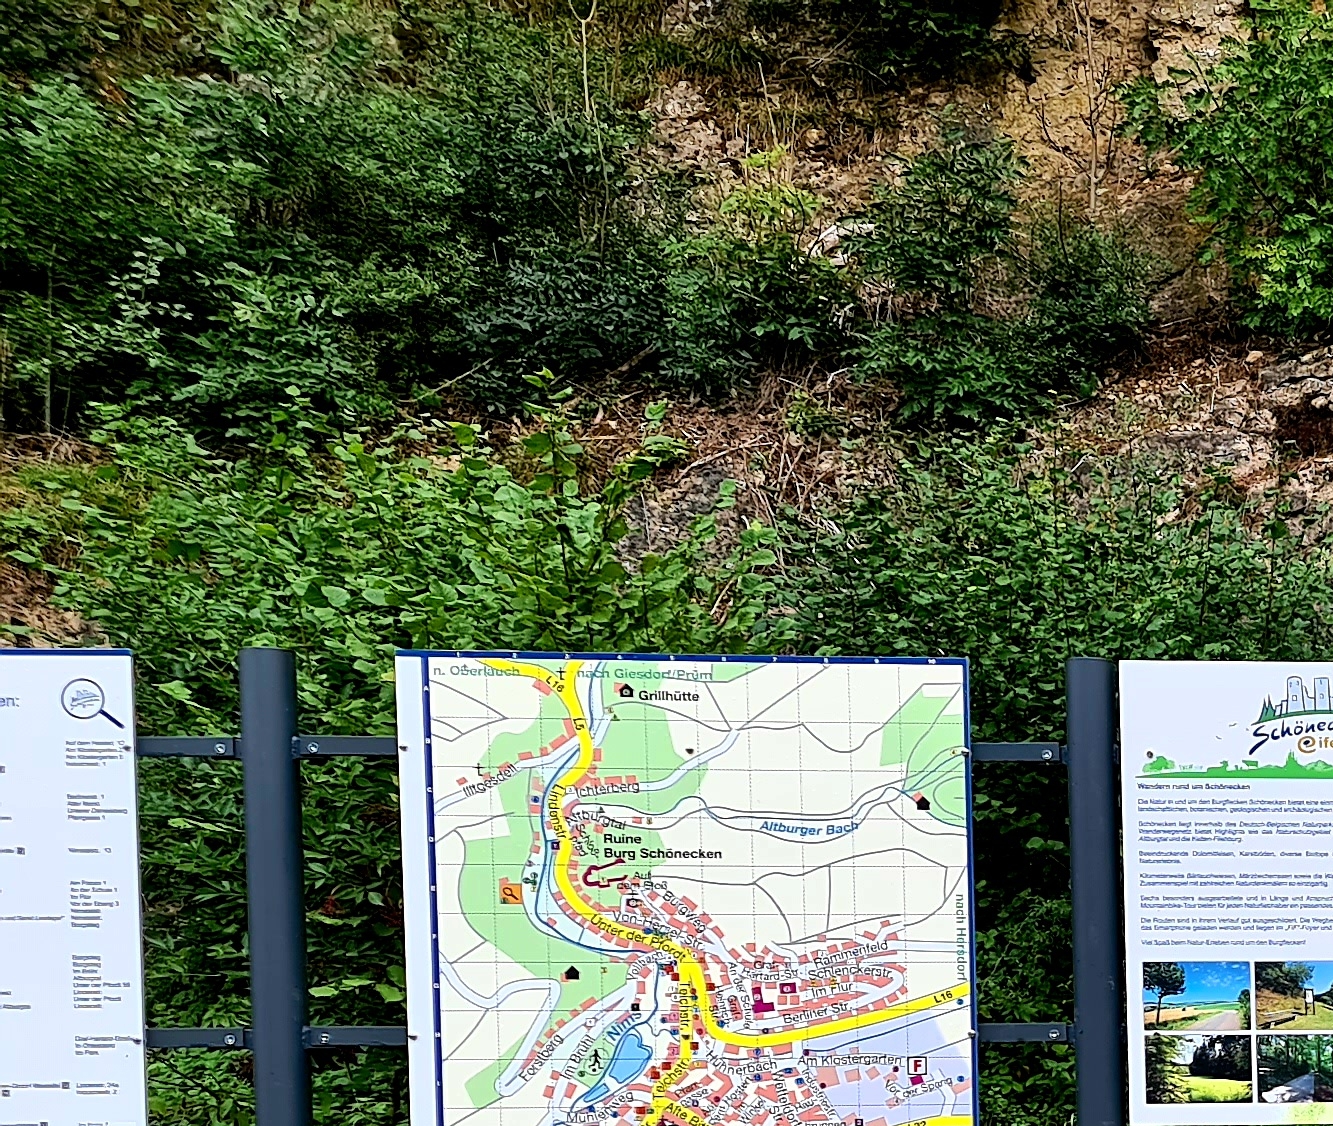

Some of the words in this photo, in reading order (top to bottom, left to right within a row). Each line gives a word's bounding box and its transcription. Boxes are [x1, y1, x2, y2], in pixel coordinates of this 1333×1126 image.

[433, 666, 445, 676] n.
[577, 668, 610, 679] nach
[638, 689, 699, 702] Grillhütte
[575, 782, 640, 797] Ichterberg
[759, 821, 823, 837] Altburger
[826, 821, 859, 836] Bach
[604, 833, 642, 844] Ruine
[604, 848, 636, 860] Burg
[640, 847, 722, 859] Schönecken
[663, 890, 706, 933] Burgweg
[956, 894, 964, 922] nach
[591, 914, 625, 936] Unter
[626, 930, 648, 943] der
[814, 940, 888, 968] Rammenfeld
[626, 950, 663, 980] Vollbach
[811, 986, 827, 998] Im
[933, 991, 953, 1004] L16
[783, 1007, 829, 1025] Berliner
[605, 1011, 642, 1042] Nims
[798, 1055, 818, 1066] Am
[822, 1054, 901, 1066] Klostergarten
[913, 1059, 923, 1073] F
[884, 1079, 903, 1094] Vor
[665, 1102, 688, 1119] Alte
